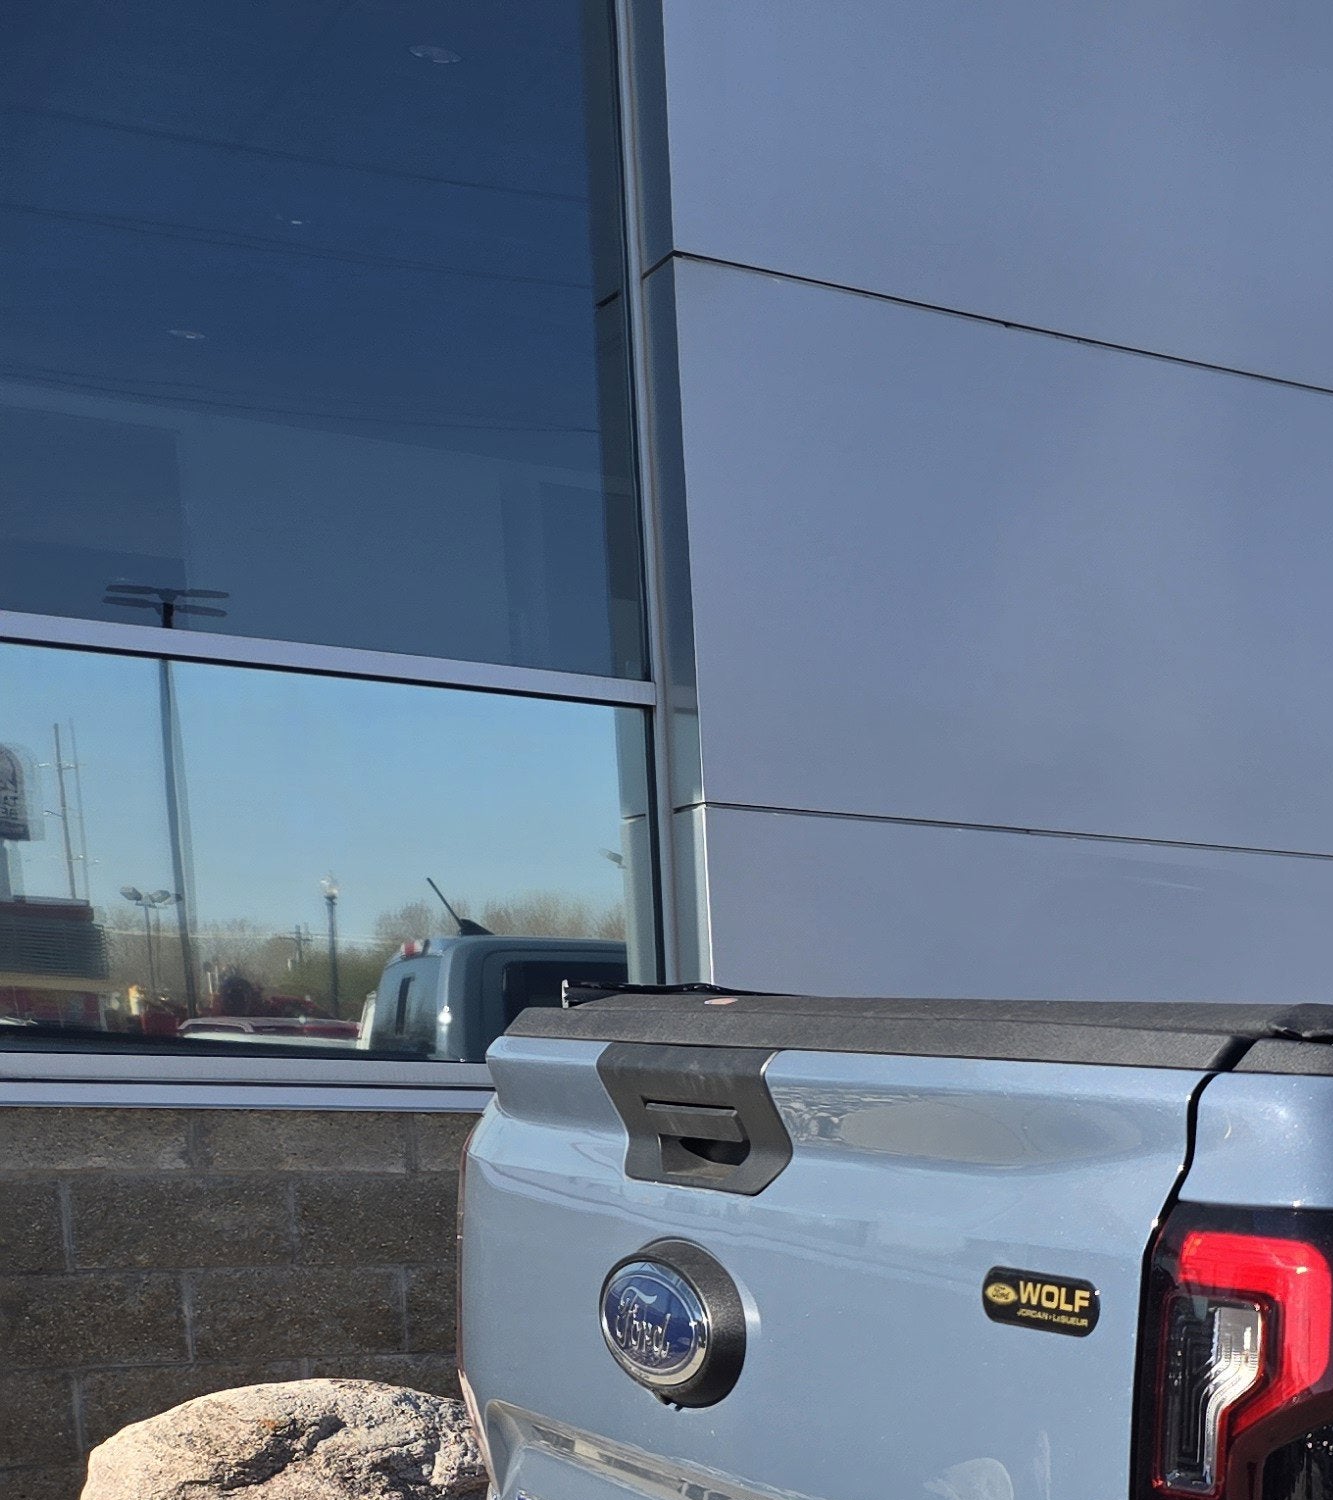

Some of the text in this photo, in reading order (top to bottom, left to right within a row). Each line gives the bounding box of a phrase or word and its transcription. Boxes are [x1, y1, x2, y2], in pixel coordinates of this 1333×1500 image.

[1019, 1280, 1090, 1313] WOLF
[616, 1286, 670, 1359] Ford
[1017, 1308, 1048, 1321] JORDAN
